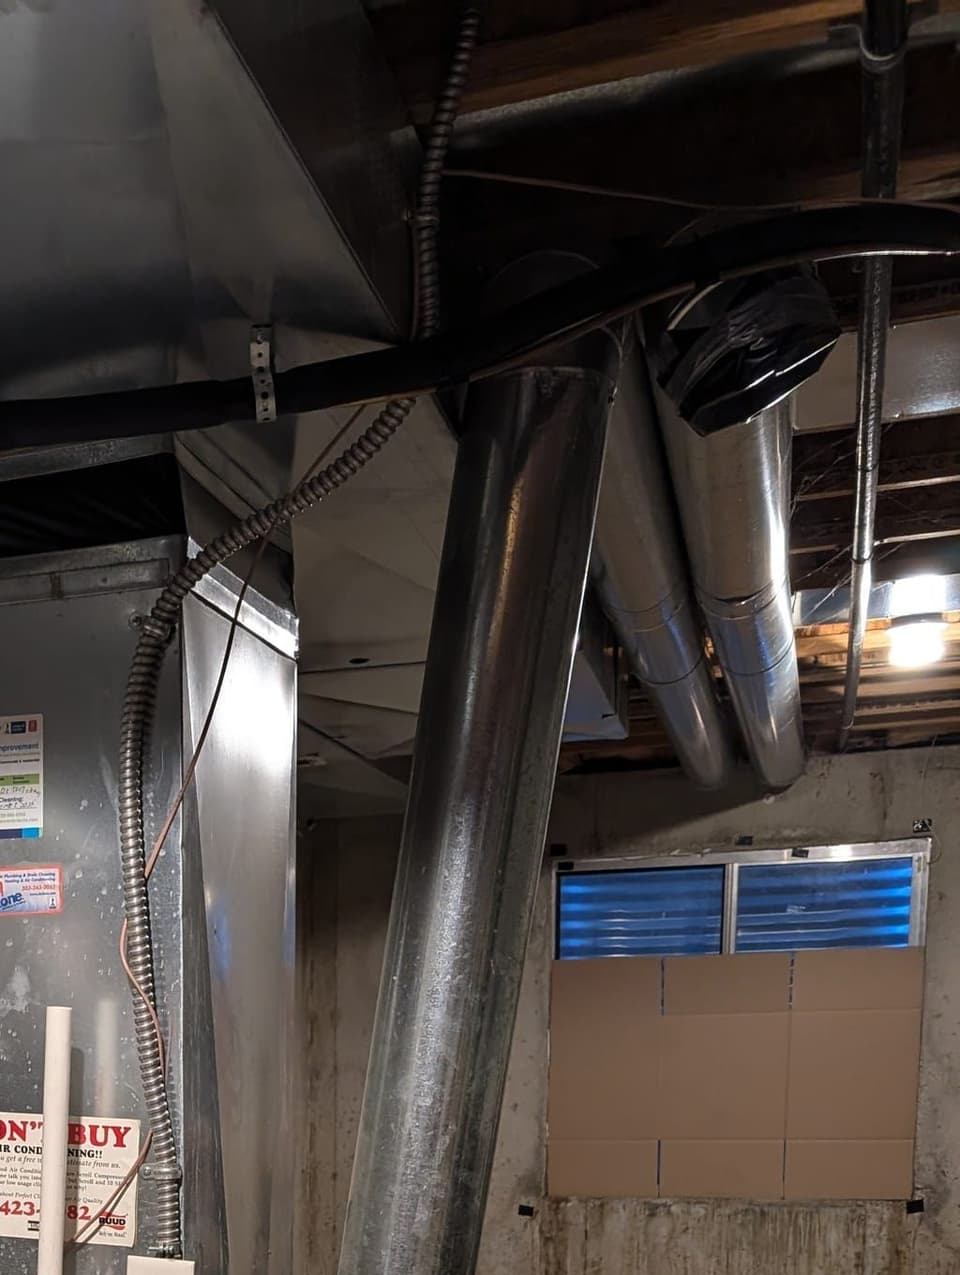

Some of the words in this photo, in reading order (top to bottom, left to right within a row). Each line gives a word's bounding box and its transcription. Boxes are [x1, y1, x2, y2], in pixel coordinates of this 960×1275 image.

[68, 1123, 132, 1148] BUY
[5, 1155, 16, 1163] get
[22, 1155, 35, 1165] free
[92, 1159, 110, 1169] from
[99, 1216, 126, 1226] RUUD
